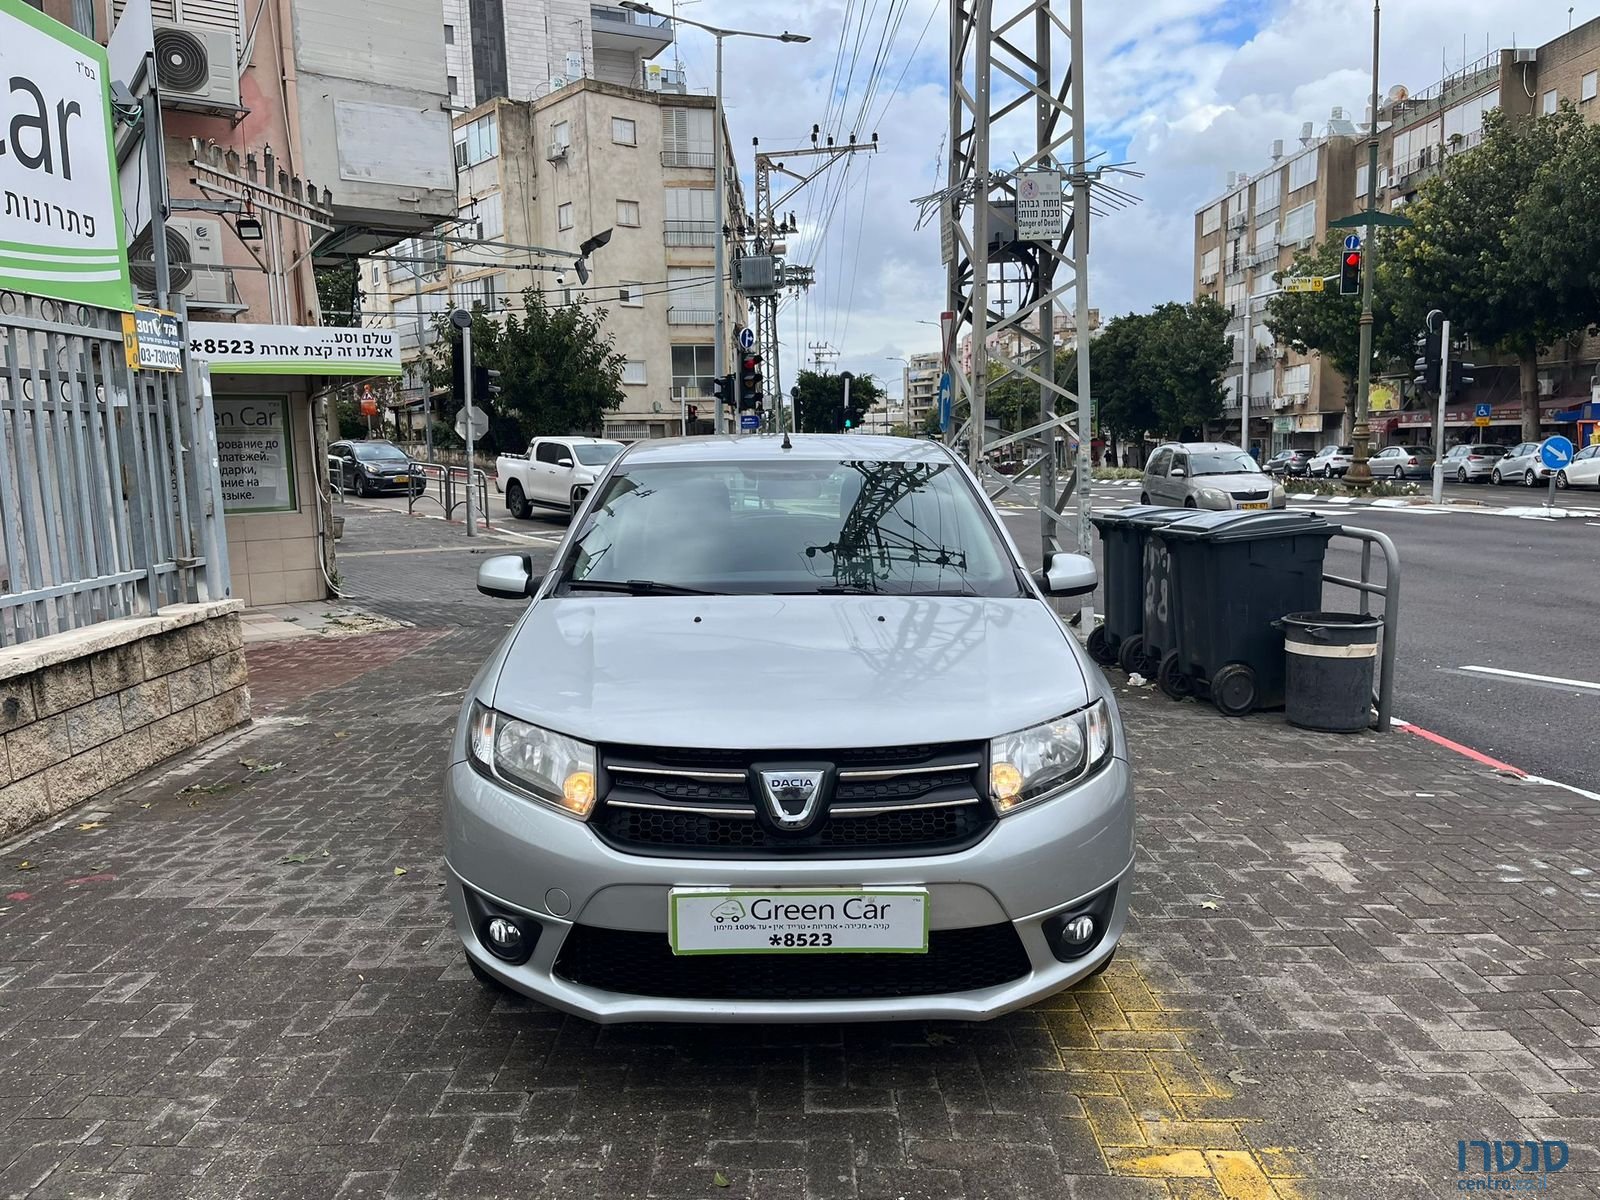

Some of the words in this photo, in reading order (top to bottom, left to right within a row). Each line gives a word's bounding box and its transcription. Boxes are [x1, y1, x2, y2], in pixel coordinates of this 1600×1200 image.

[75, 61, 96, 80] בס"ד
[0, 76, 81, 181] ar
[4, 190, 95, 238] פתרונות
[136, 319, 154, 335] 301
[363, 333, 392, 344] שלם
[260, 344, 299, 356] אחרת
[304, 345, 333, 359] קצת
[338, 346, 352, 357] זה
[357, 346, 393, 358] אצלנו
[240, 406, 276, 426] Car
[265, 440, 279, 450] до
[246, 478, 259, 487] на
[771, 779, 813, 788] DACIA
[751, 898, 834, 921] Green
[843, 897, 891, 920] Car
[713, 924, 733, 932] מימון
[873, 923, 890, 931] קניה
